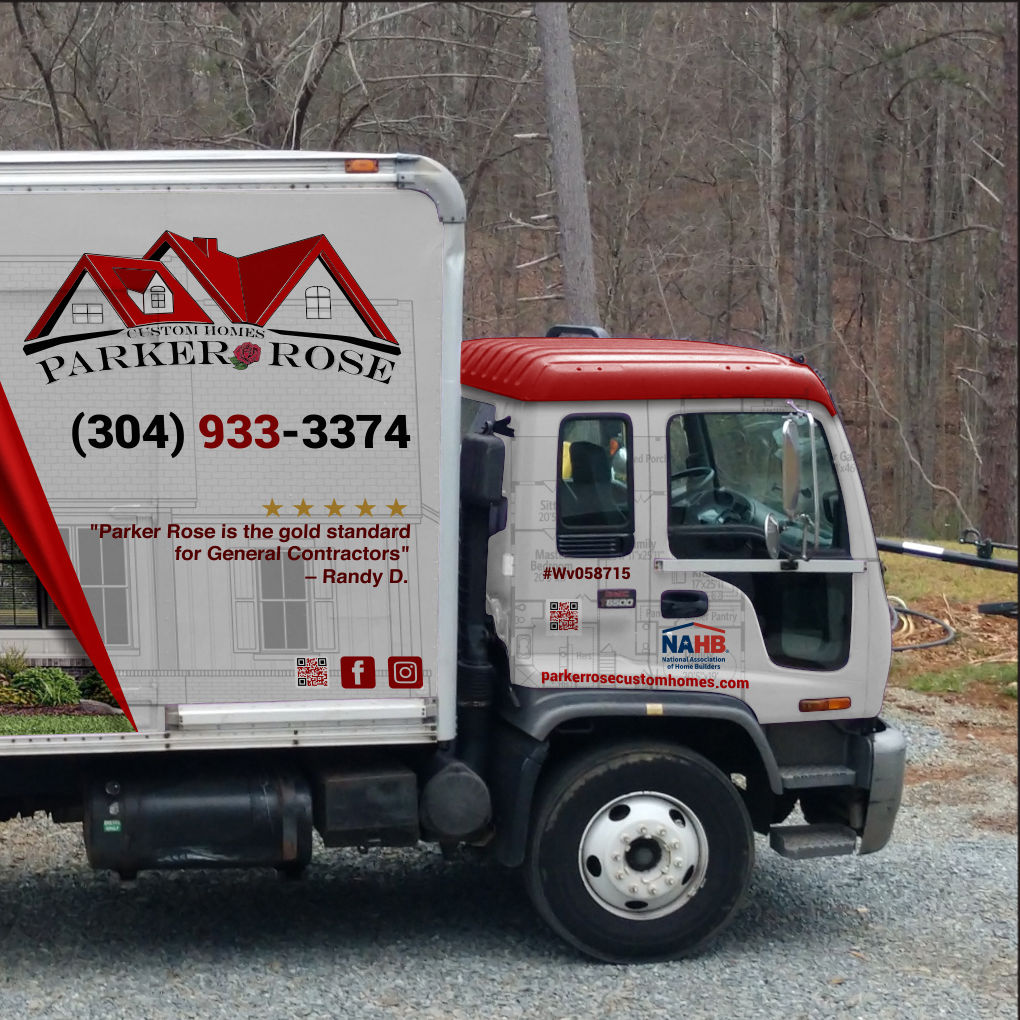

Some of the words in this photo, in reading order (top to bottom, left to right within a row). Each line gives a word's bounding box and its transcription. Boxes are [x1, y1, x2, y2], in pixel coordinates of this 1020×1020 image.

[126, 325, 200, 339] CUSTOM
[204, 325, 266, 340] HOMES
[35, 340, 232, 385] PARKER
[268, 341, 396, 385] ROSE
[72, 411, 185, 458] (304)
[198, 414, 410, 449] 933-3374
[90, 523, 161, 539] "Parker
[167, 524, 216, 539] Rose
[221, 524, 238, 539] is
[243, 524, 274, 539] the
[278, 523, 321, 542] gold
[326, 523, 411, 539] standard
[175, 546, 201, 561] for
[207, 545, 281, 561] General
[287, 545, 410, 561] Contractors"
[322, 569, 384, 587] Randy
[389, 570, 408, 584] D.
[543, 567, 631, 580] #Wv058715
[542, 669, 749, 689] parkerrosecustomhomes.com
